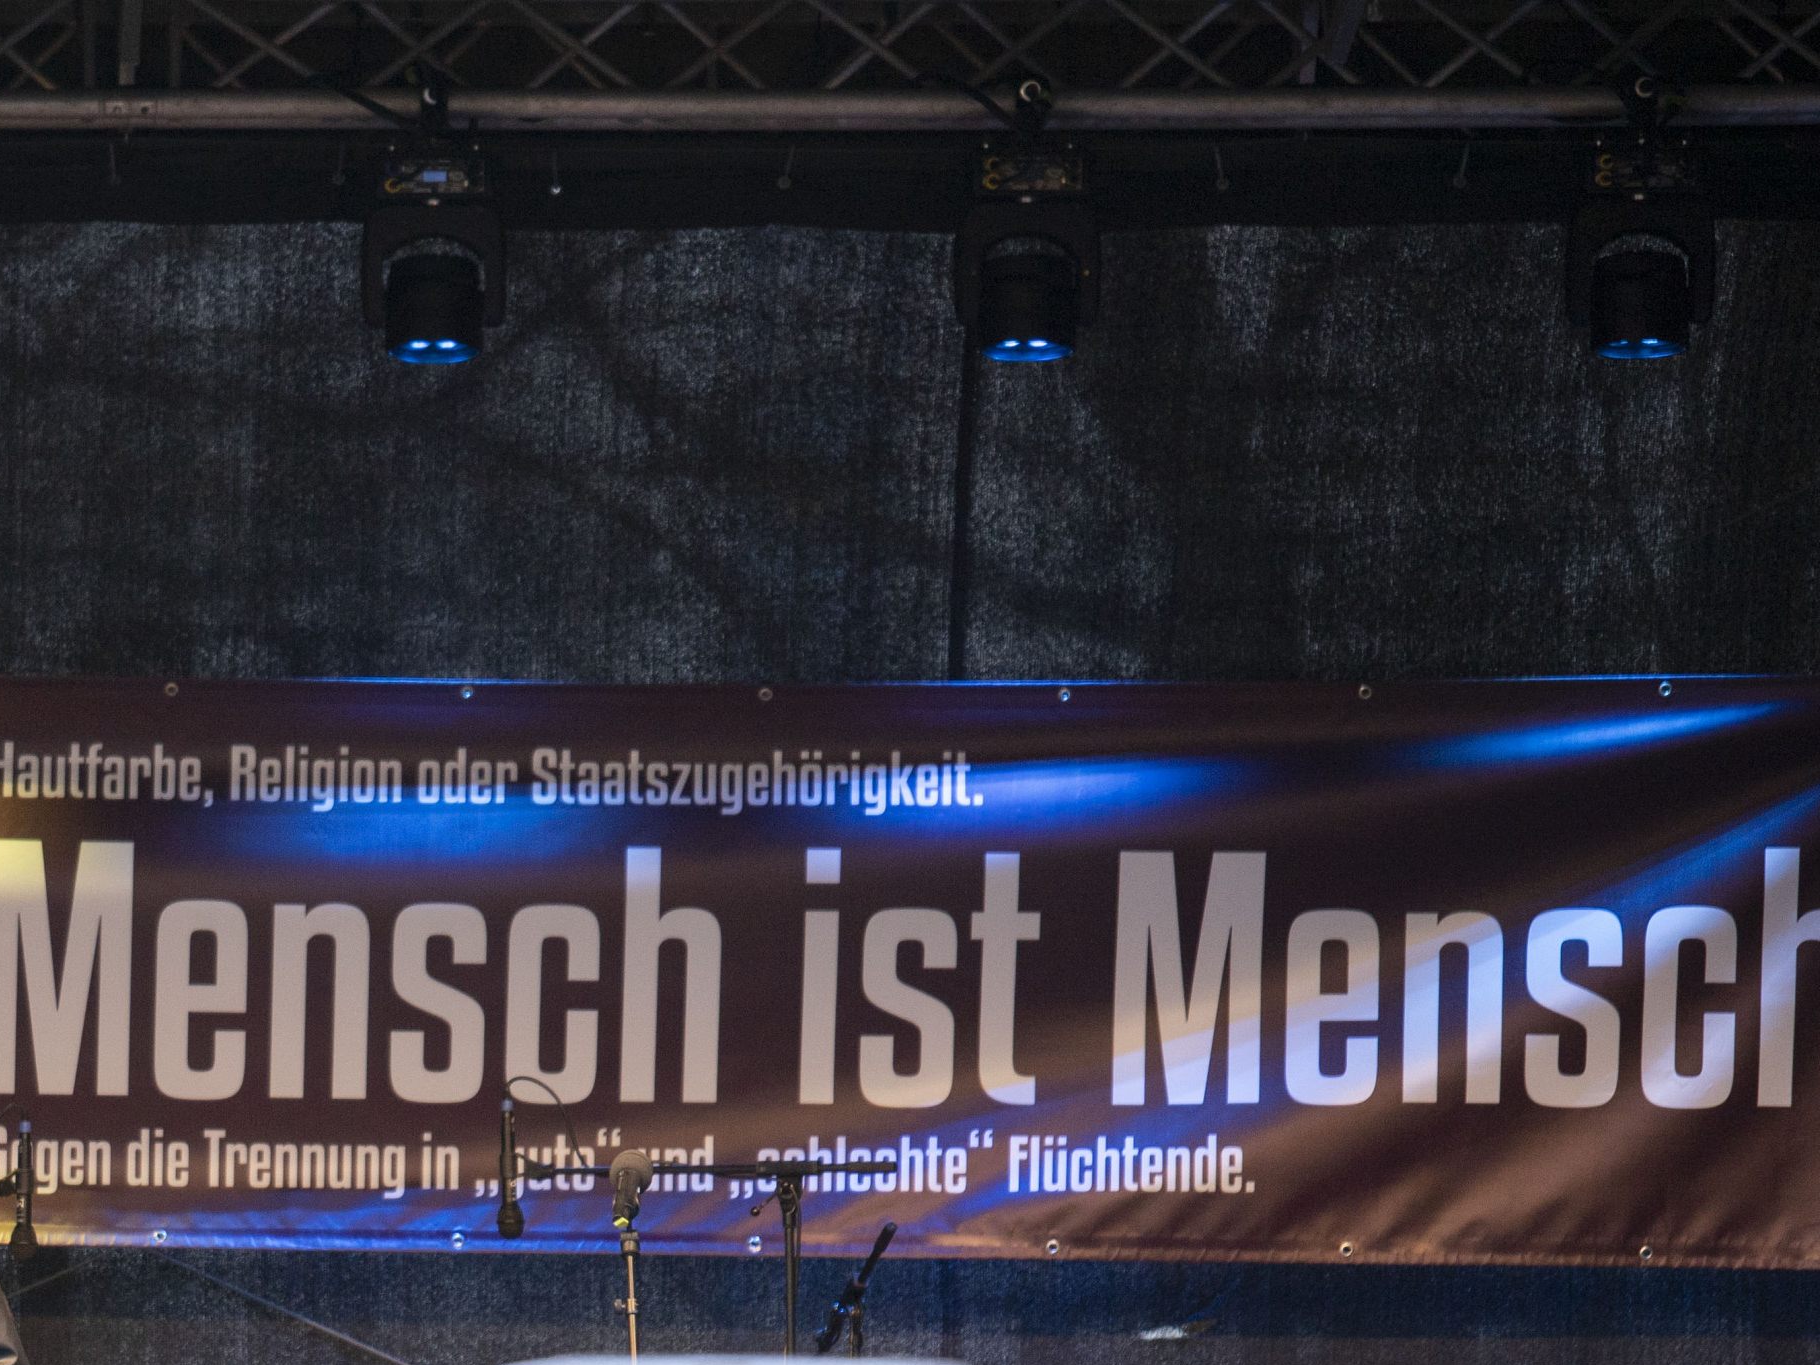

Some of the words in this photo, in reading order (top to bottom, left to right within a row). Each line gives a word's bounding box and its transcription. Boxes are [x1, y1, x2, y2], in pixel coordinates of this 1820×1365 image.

[230, 744, 403, 813] Religion
[417, 748, 519, 805] oder
[531, 747, 984, 816] Staatszugehörigkeit.
[798, 846, 1042, 1108] ist
[126, 1128, 190, 1188] die
[203, 1128, 407, 1200] Trennung
[422, 1131, 460, 1191] in
[1009, 1133, 1256, 1195] Flüchtende.
